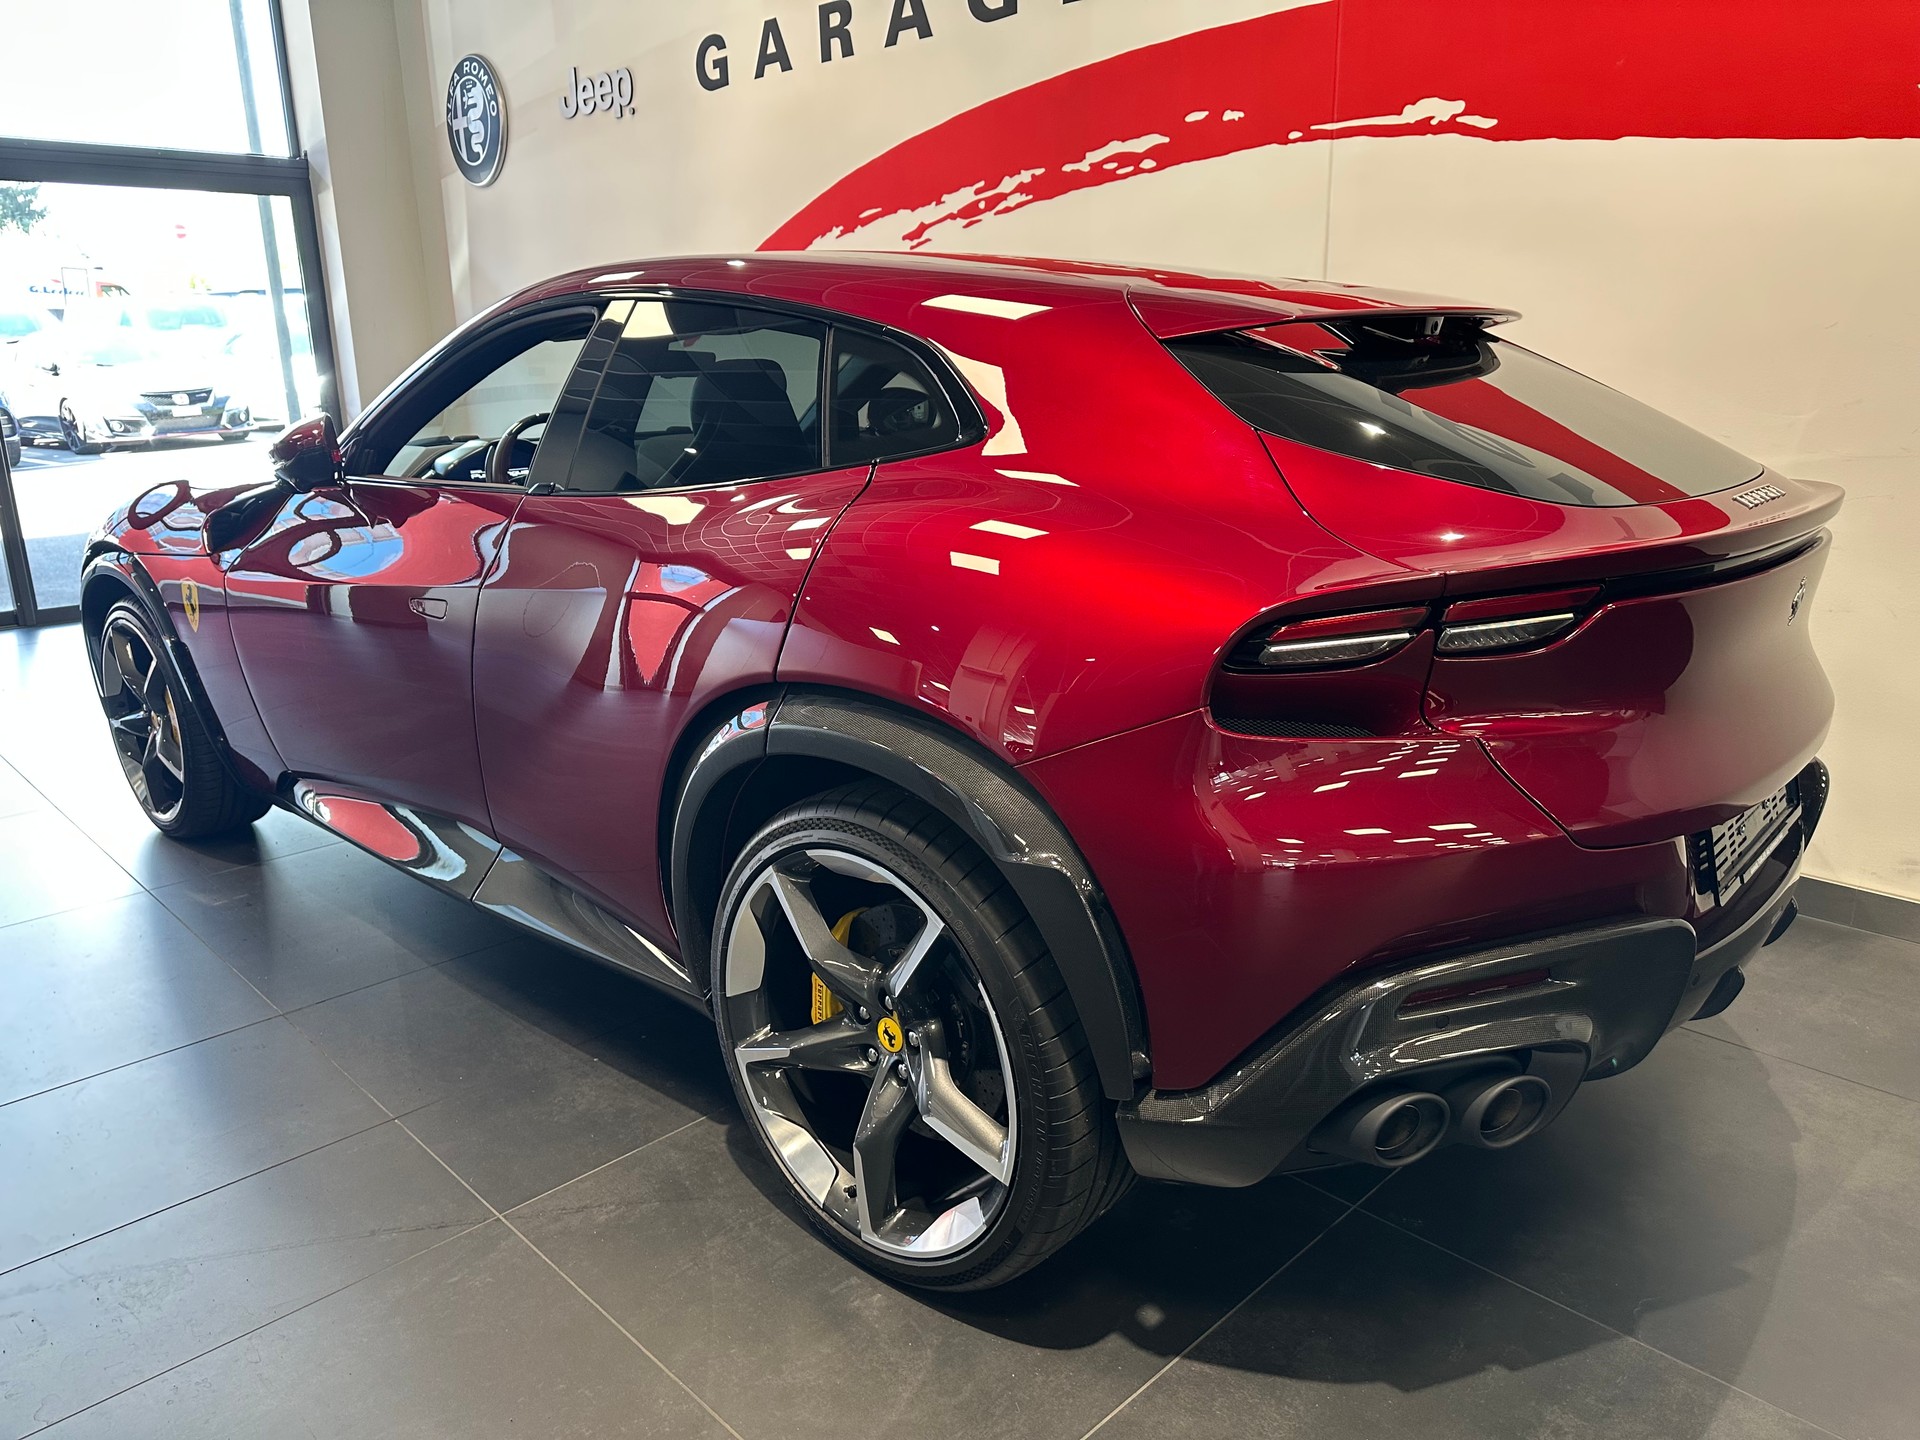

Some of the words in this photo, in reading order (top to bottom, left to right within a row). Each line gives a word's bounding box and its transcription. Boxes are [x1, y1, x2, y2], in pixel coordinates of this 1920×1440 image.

[695, 0, 1079, 92] GARA
[447, 72, 460, 126] ALFA
[463, 61, 498, 117] ROMEO
[559, 66, 634, 120] Jeep
